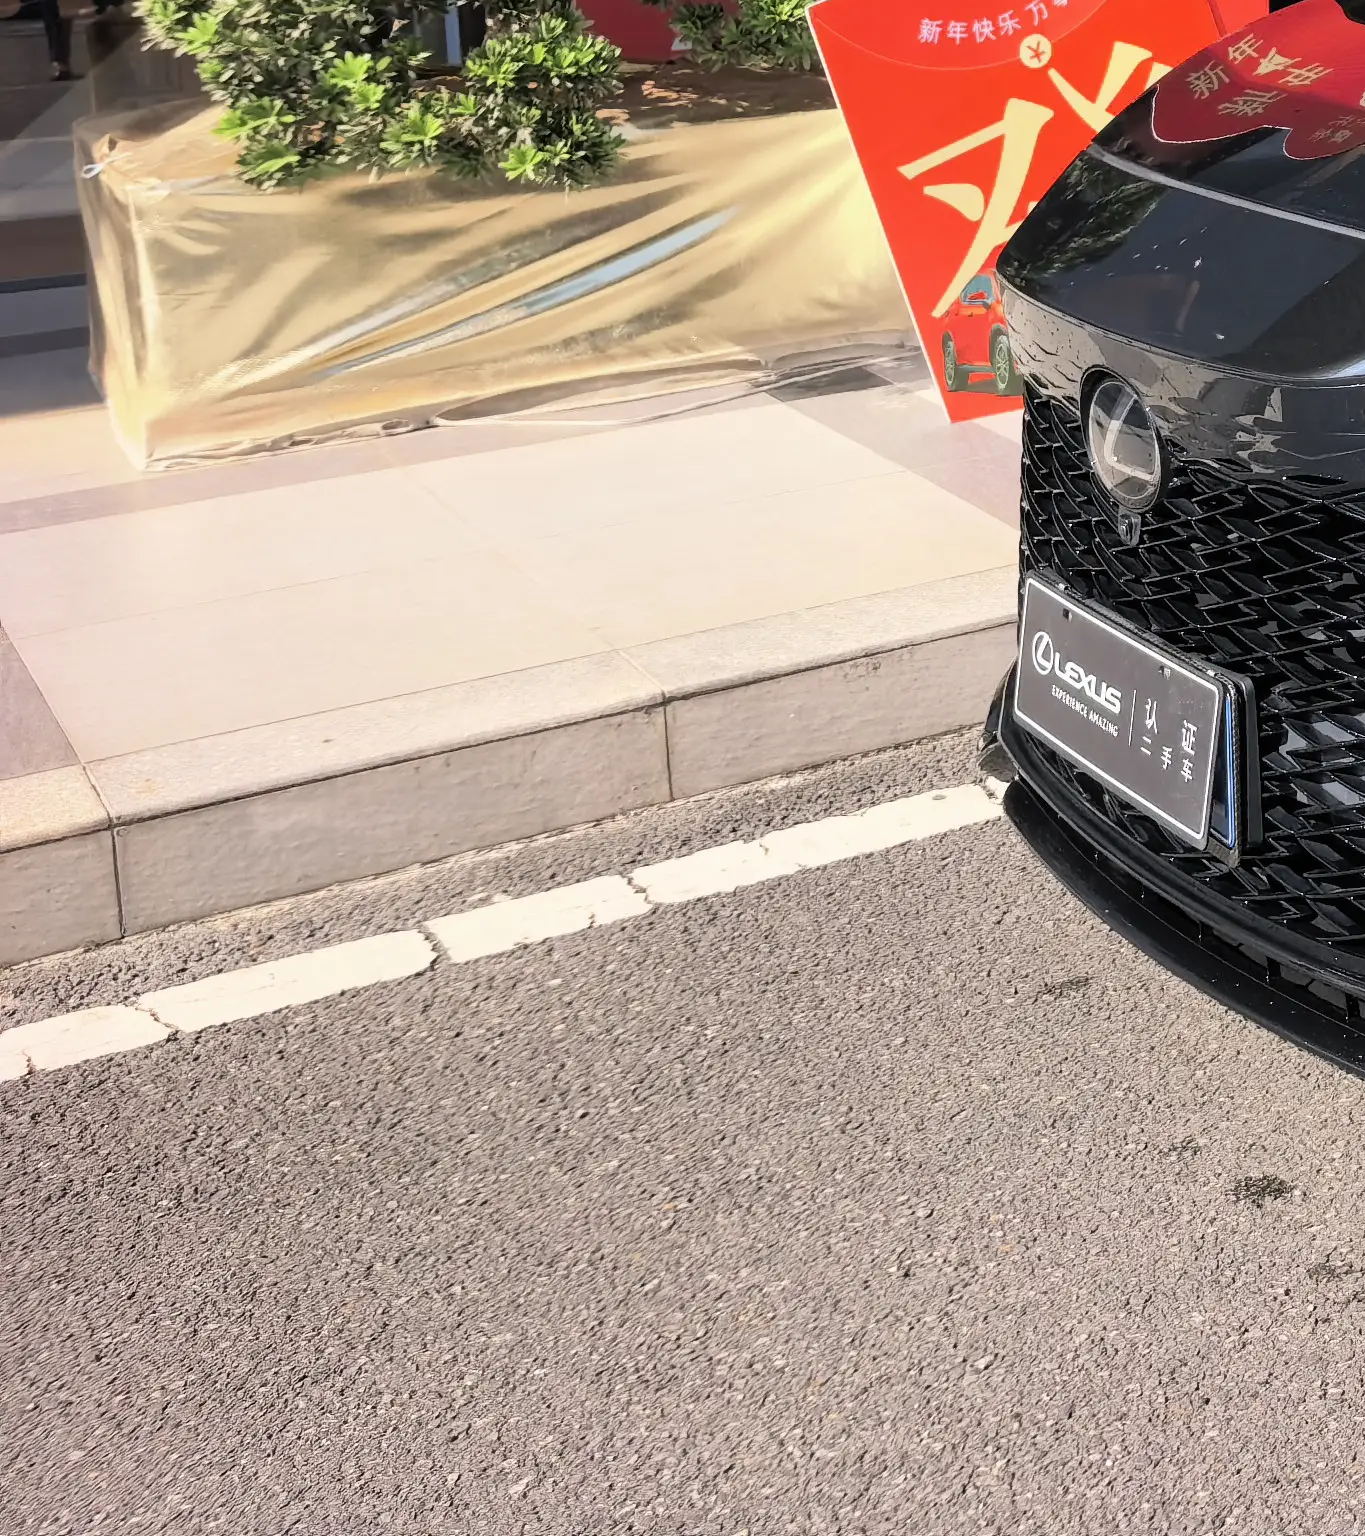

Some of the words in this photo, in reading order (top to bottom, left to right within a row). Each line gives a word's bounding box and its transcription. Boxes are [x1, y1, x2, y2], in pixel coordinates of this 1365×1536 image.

[918, 10, 1022, 46] 新年快乐
[1054, 651, 1122, 714] LEXUS
[1051, 683, 1088, 719] EXPERIENCE
[1088, 710, 1119, 738] AMAZING
